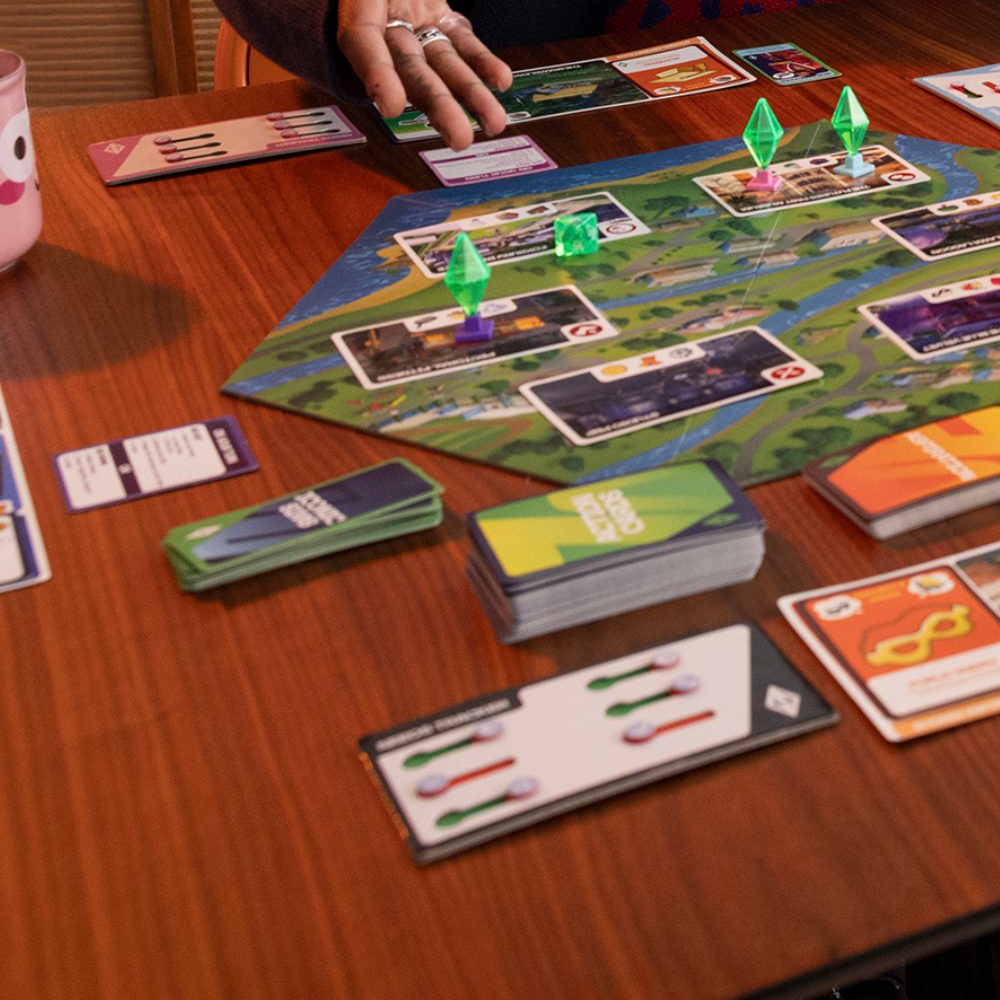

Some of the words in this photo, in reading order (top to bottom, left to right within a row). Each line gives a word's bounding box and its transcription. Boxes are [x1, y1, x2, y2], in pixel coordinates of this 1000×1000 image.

[278, 501, 320, 530] SIMS
[293, 490, 347, 526] ICONIC
[570, 492, 623, 544] ACTION
[598, 488, 645, 535] CARDS
